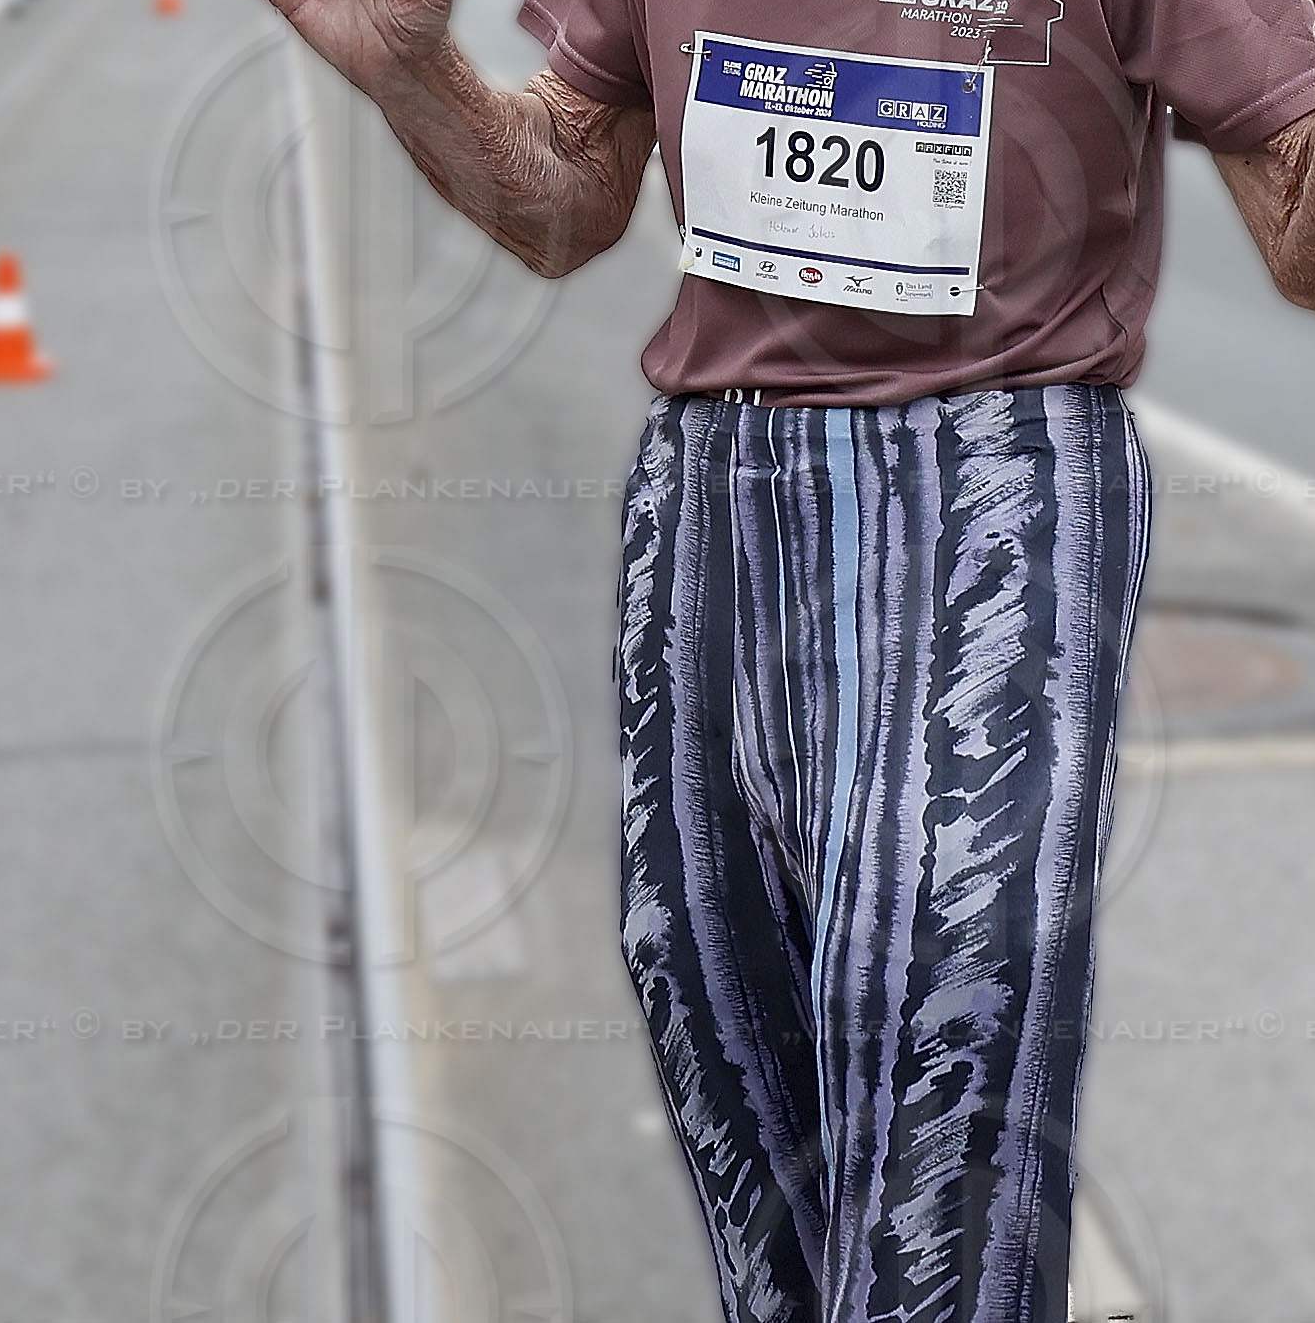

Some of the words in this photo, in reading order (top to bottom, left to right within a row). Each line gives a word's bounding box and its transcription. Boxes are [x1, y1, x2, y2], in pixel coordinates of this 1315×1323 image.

[900, 7, 973, 25] MARATHON
[950, 25, 982, 38] 2023
[744, 63, 788, 84] GRAZ
[739, 79, 835, 108] MARATHON
[879, 101, 946, 121] GRAZ
[755, 125, 885, 193] 1820
[750, 190, 783, 207] Kleine
[785, 197, 827, 216] Zeitung
[830, 203, 884, 221] Marathon
